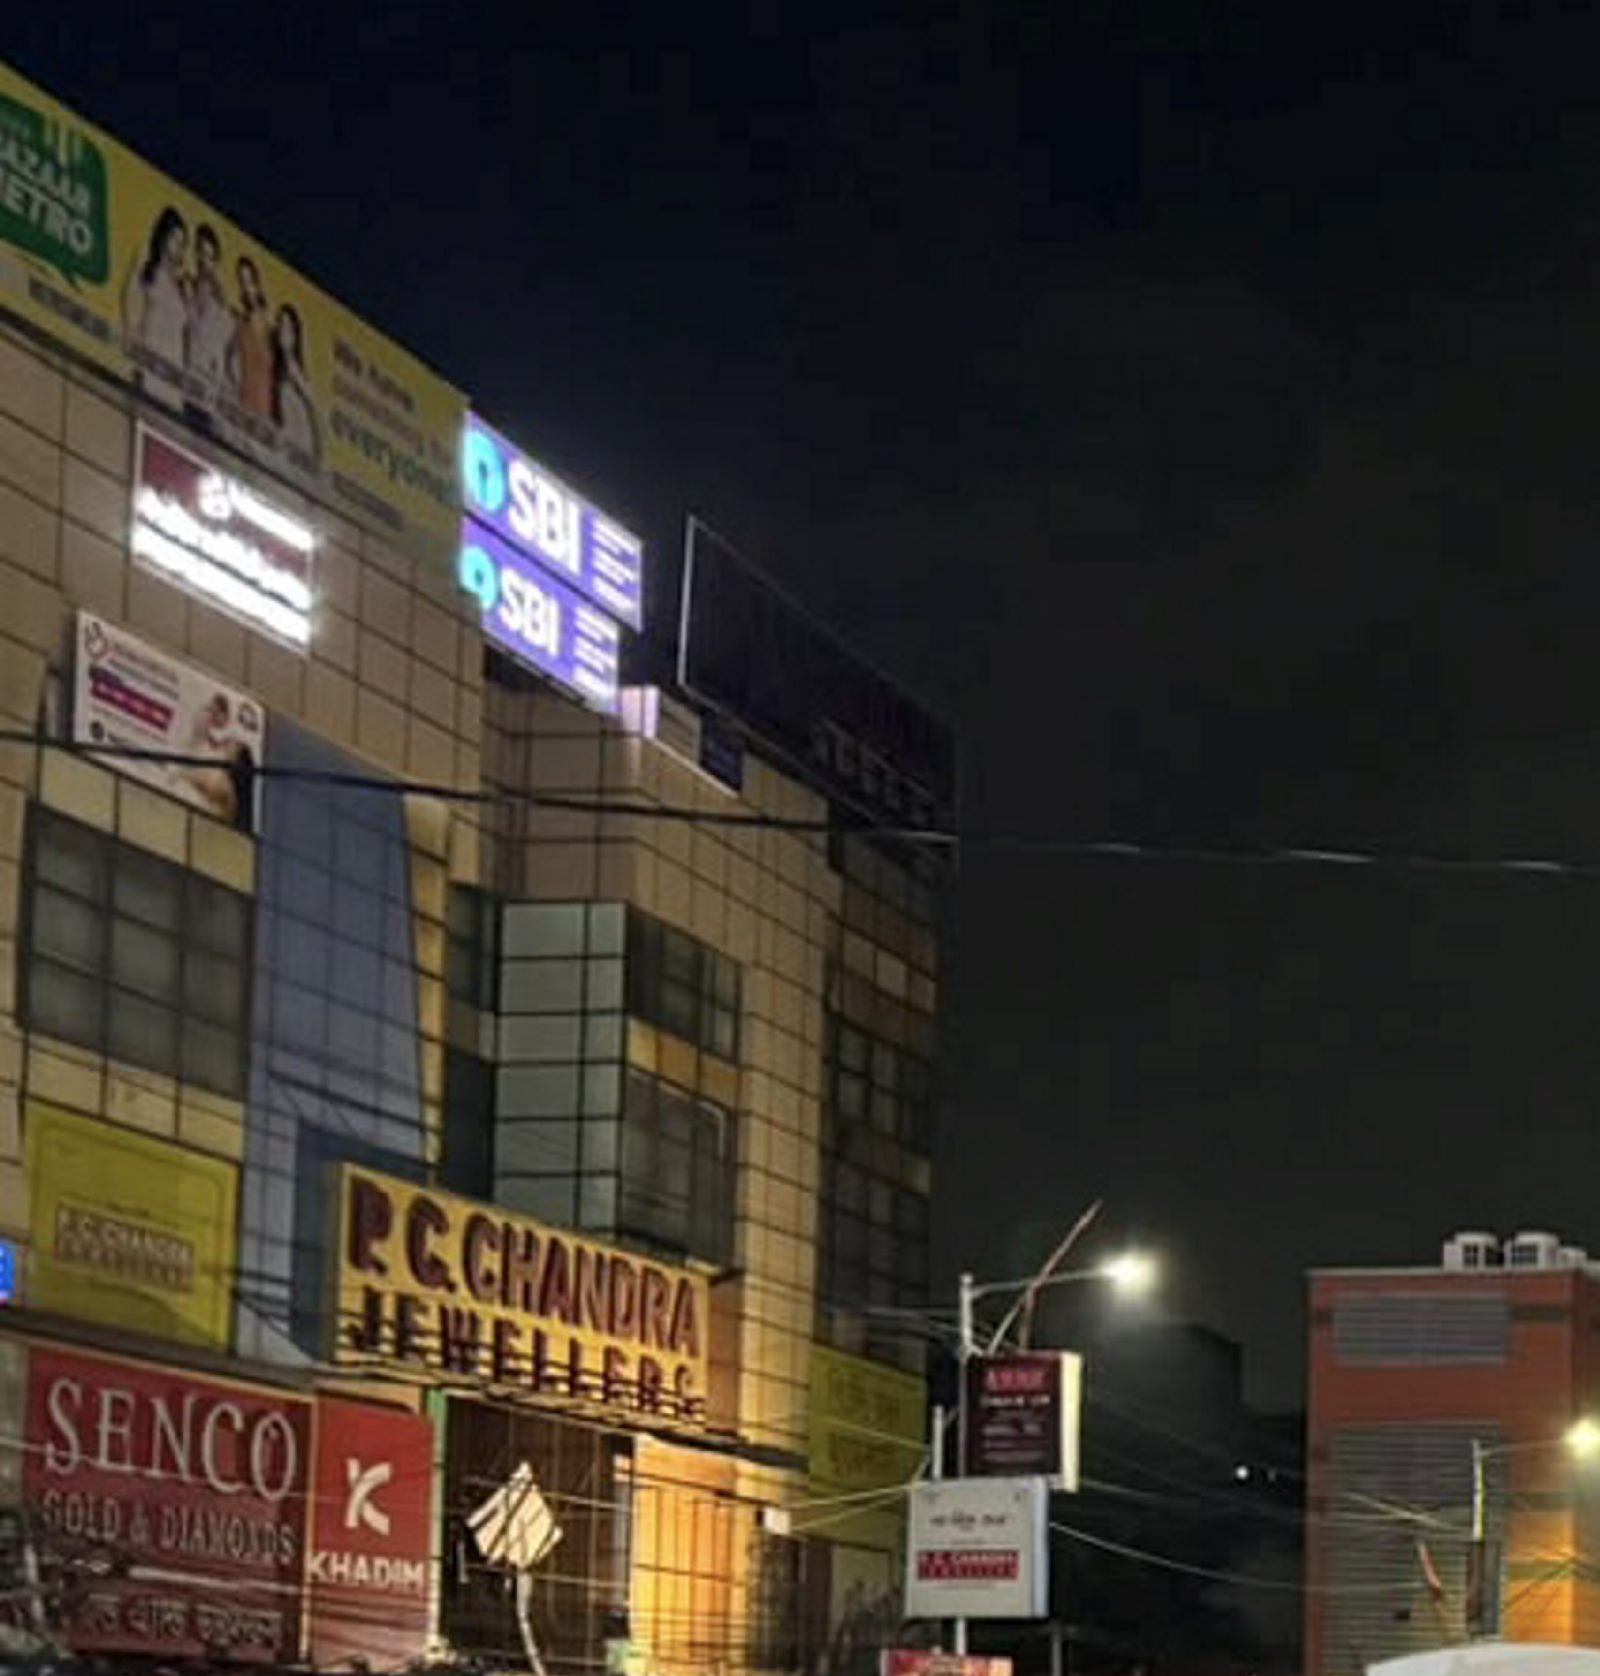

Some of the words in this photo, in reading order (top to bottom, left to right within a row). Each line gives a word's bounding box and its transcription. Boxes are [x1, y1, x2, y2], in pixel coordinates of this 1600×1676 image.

[0, 173, 95, 256] ETRO
[508, 459, 582, 577] SBI
[500, 567, 559, 657] SBI
[462, 1211, 699, 1359] CHANDRA
[349, 1283, 705, 1420] JEWELLERS
[46, 1378, 297, 1502] SENCO
[43, 1487, 122, 1541] GOLD
[159, 1506, 297, 1566] DIAMONDS
[307, 1550, 425, 1594] KHADIM
